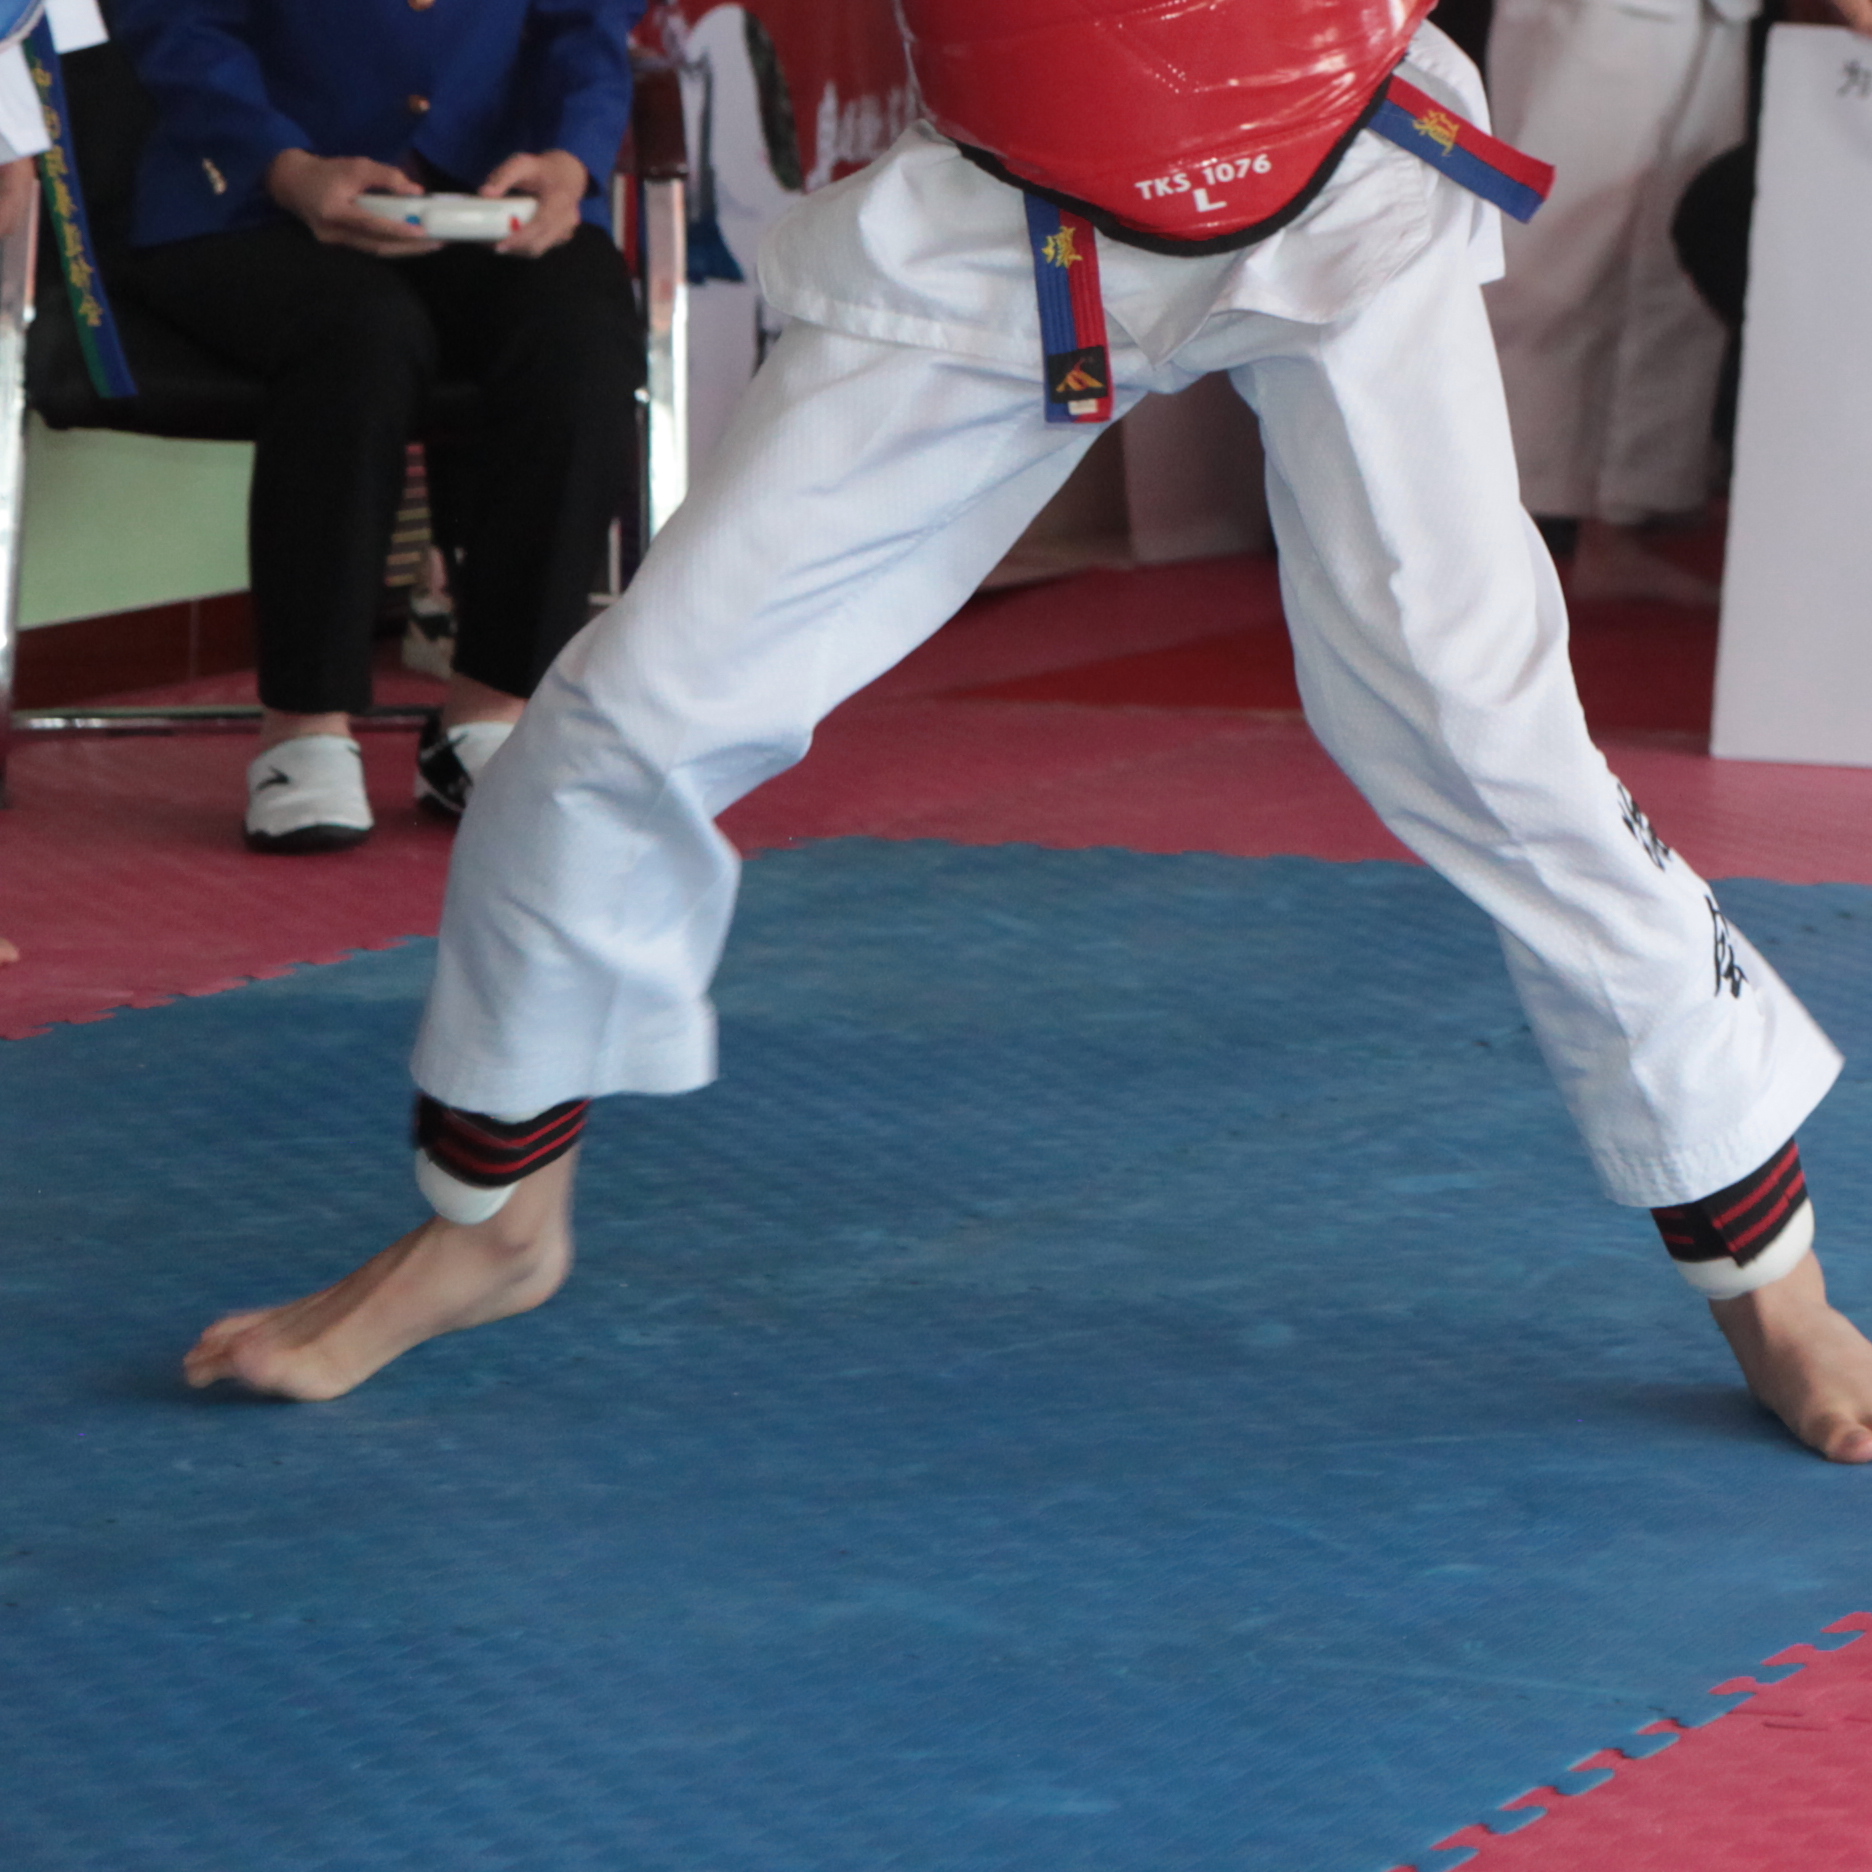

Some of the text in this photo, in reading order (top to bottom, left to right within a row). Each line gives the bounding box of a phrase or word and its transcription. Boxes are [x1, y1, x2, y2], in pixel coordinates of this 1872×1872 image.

[1134, 153, 1273, 201] TKS 1076
[1193, 188, 1228, 213] L
